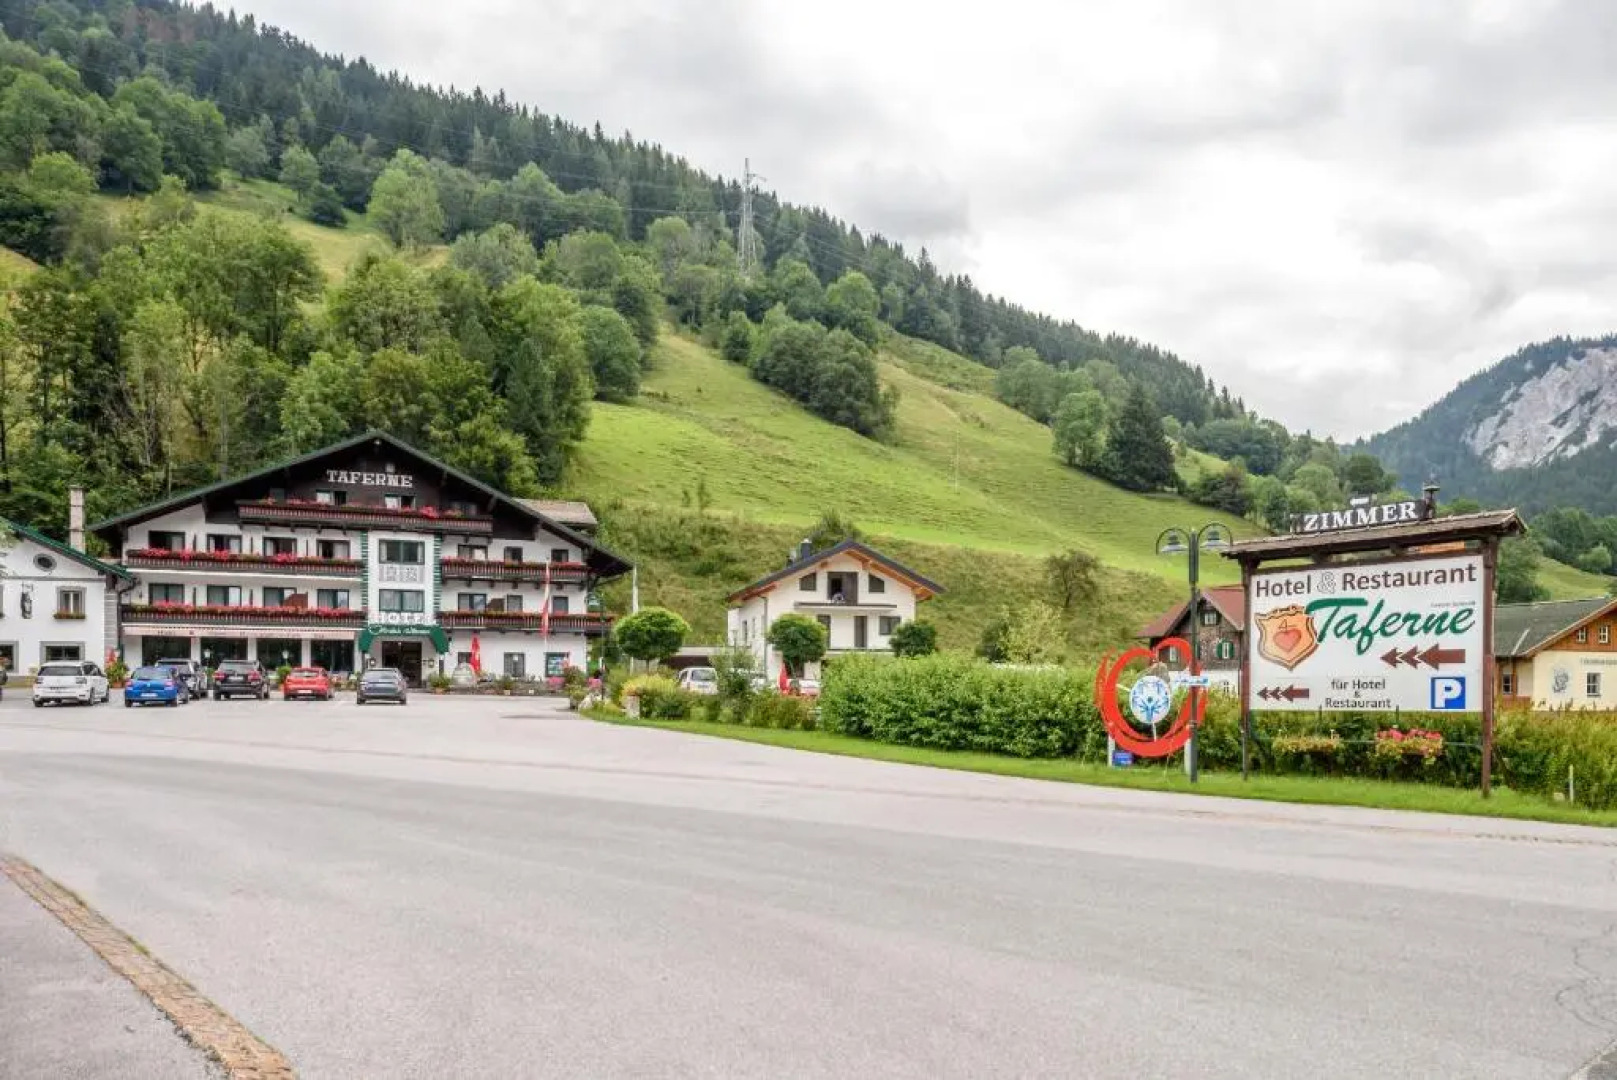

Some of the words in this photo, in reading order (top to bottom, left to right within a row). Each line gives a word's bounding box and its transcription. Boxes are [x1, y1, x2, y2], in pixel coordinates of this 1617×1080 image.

[326, 469, 413, 488] TAFERNE
[1303, 501, 1419, 531] ZIMMER
[1256, 575, 1311, 597] Hotel
[1316, 571, 1337, 594] &
[1342, 563, 1477, 591] Restaurant
[1305, 597, 1475, 655] Taferne
[1331, 678, 1349, 690] für
[1352, 678, 1386, 690] Hotel
[1434, 678, 1462, 708] P
[1325, 697, 1391, 708] Restaurant
